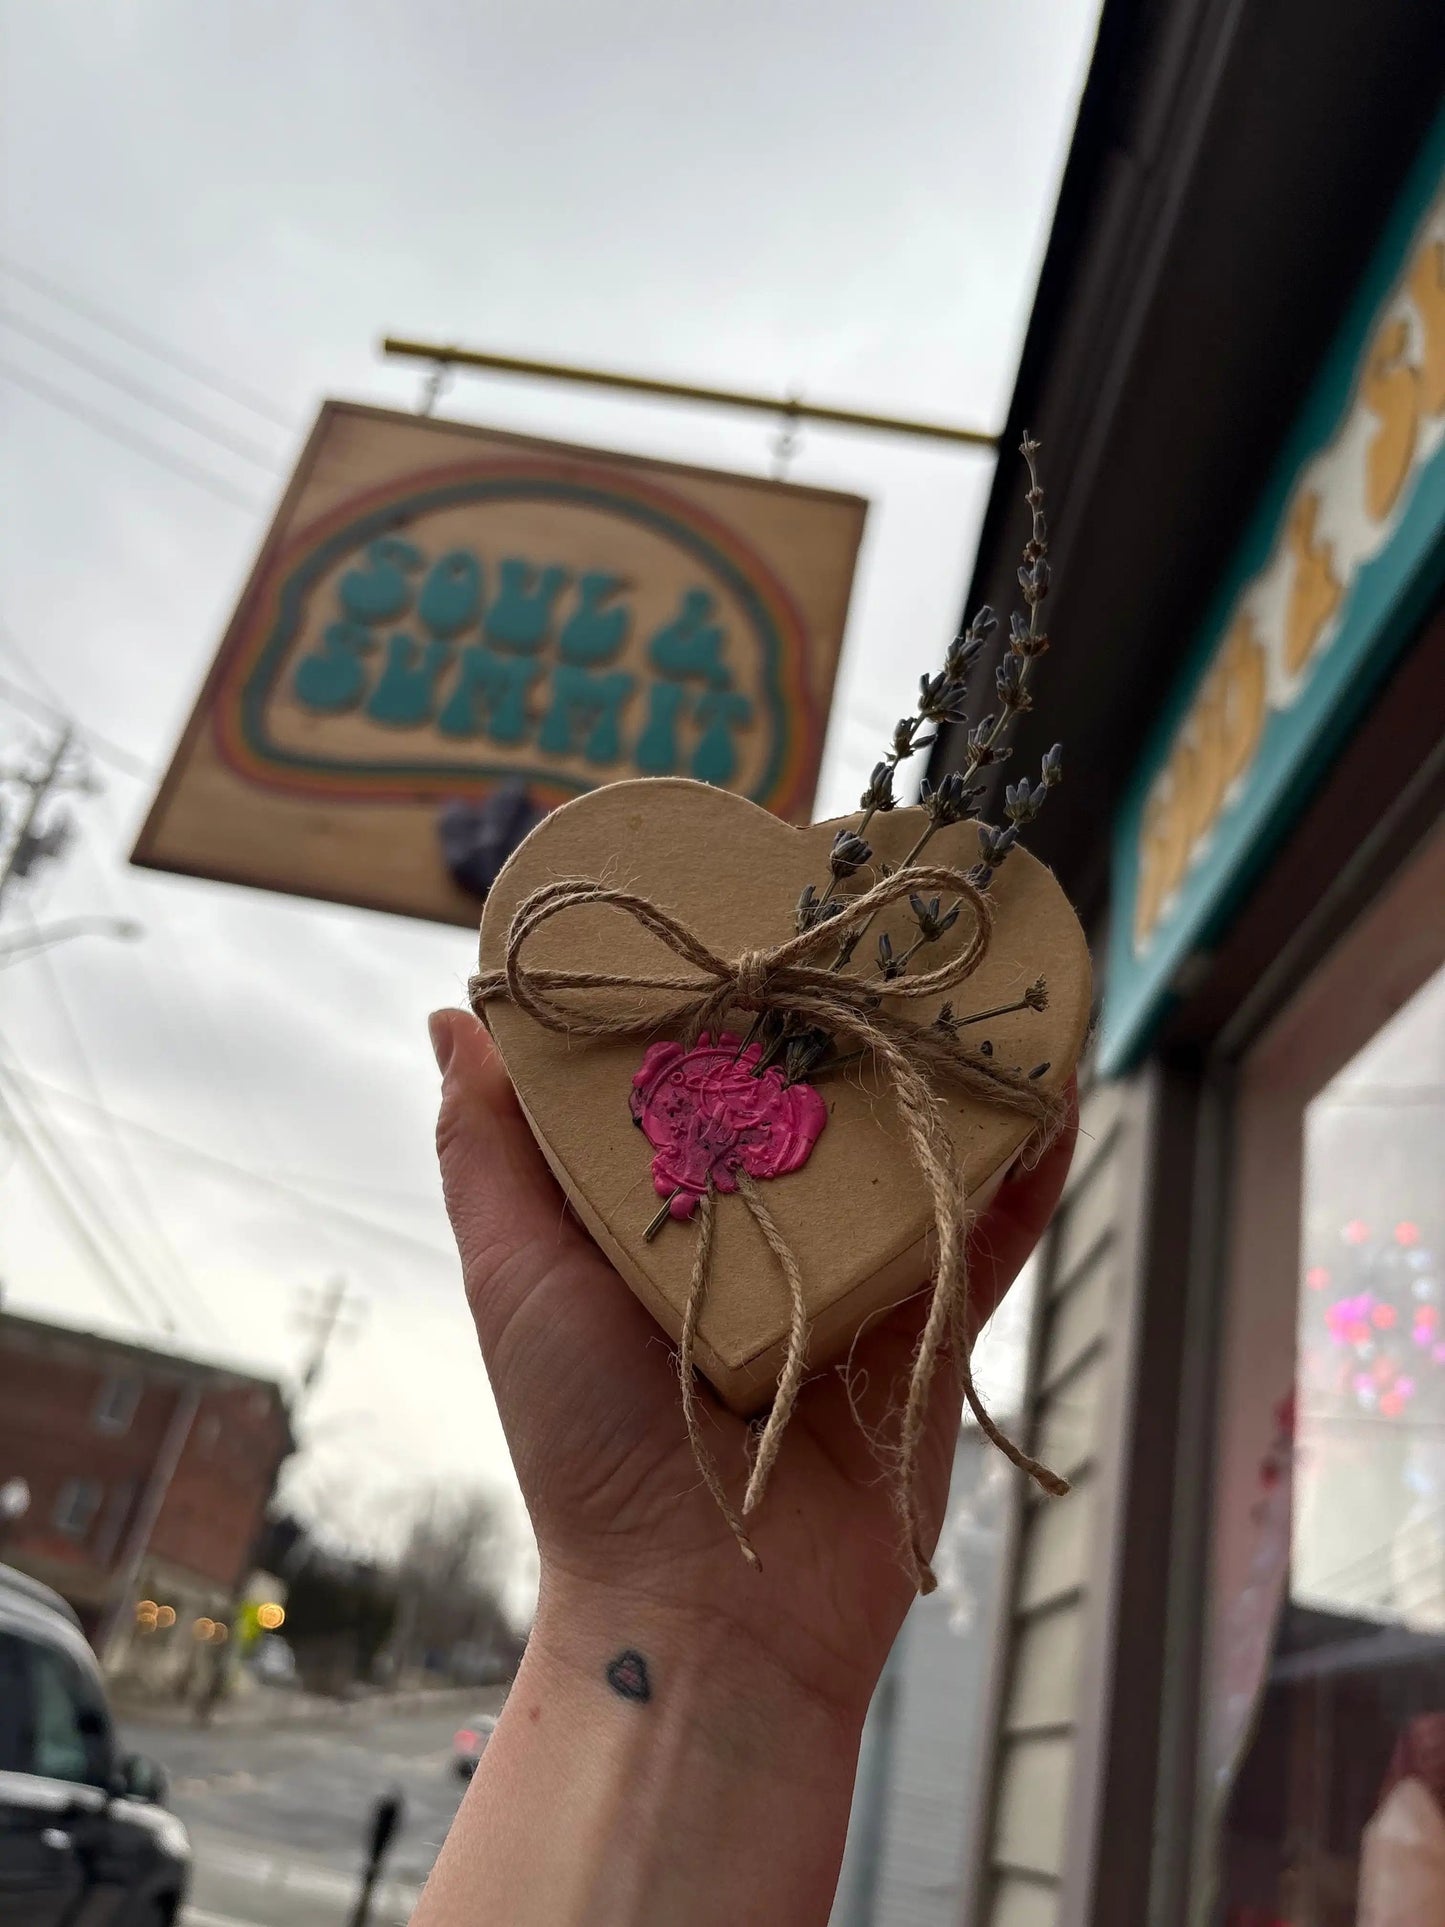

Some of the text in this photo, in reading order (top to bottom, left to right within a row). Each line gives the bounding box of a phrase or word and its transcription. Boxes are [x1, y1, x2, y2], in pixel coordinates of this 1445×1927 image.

[339, 537, 734, 688] SOUL &
[294, 621, 752, 783] SUMMIT
